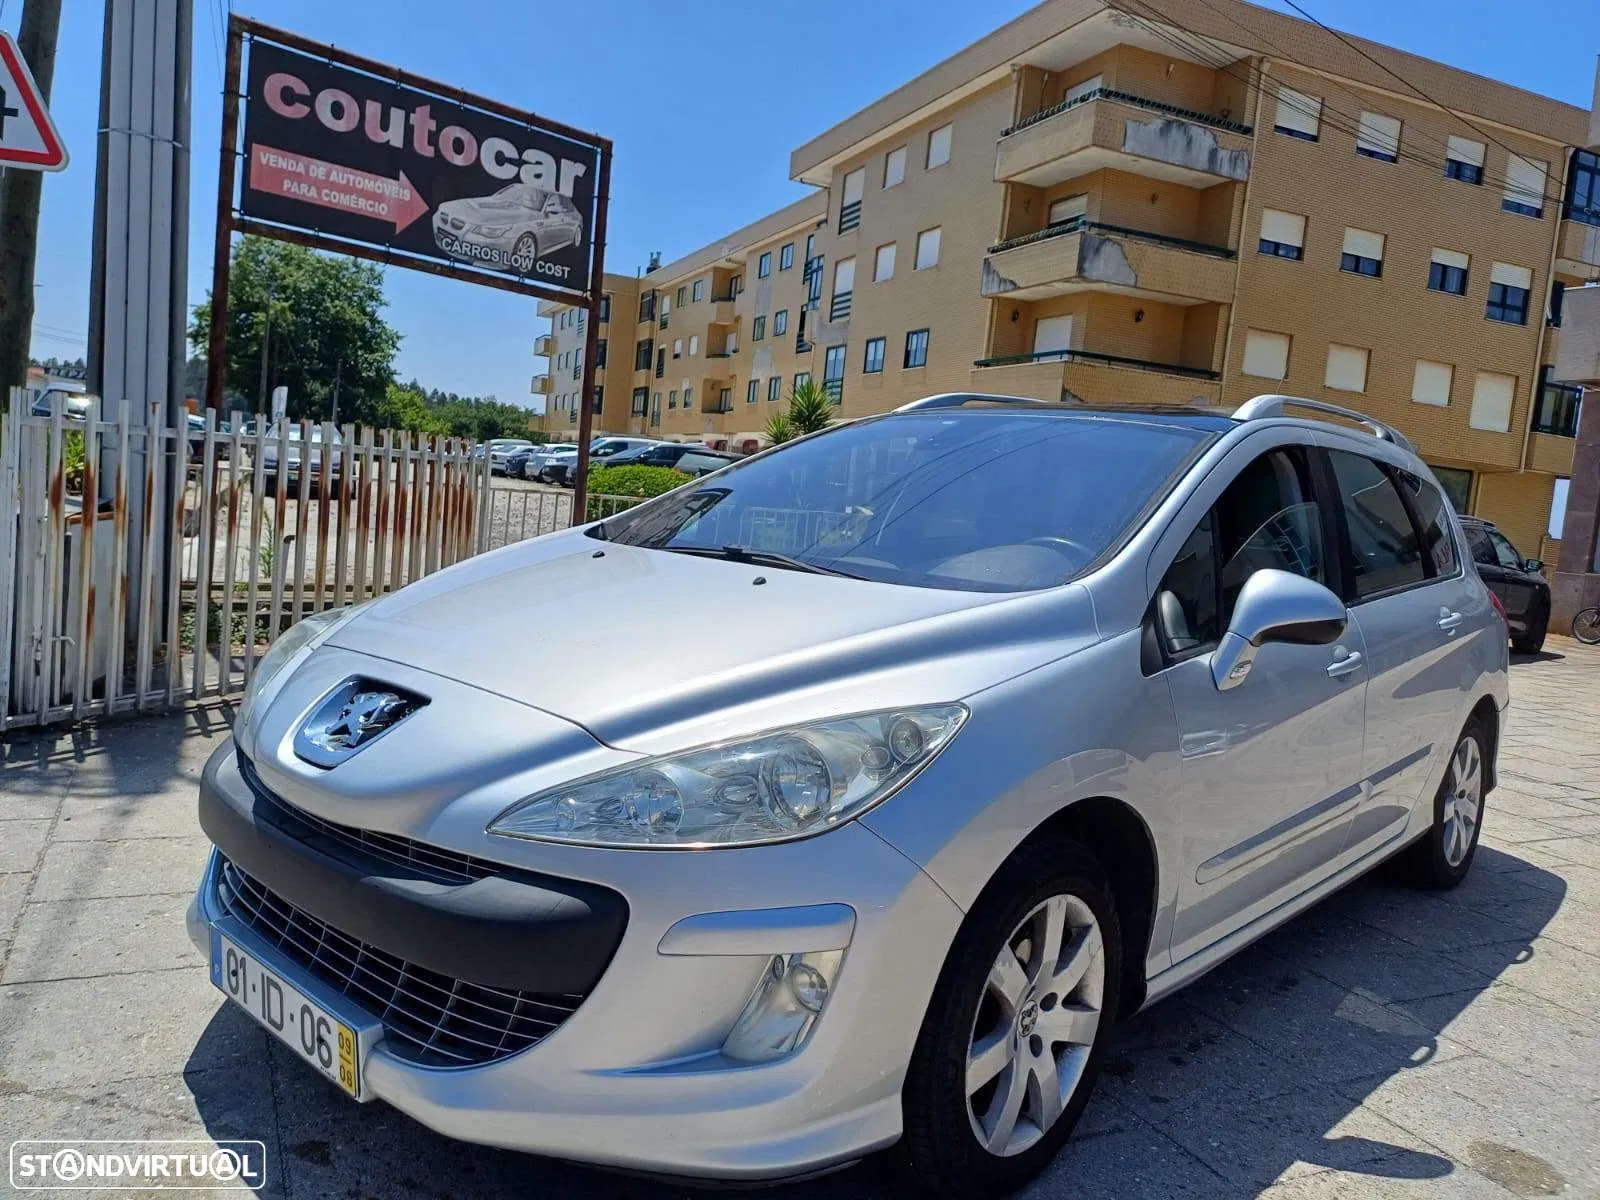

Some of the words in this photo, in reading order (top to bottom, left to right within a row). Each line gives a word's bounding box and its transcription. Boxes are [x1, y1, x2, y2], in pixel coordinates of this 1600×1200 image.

[263, 72, 587, 197] coutocar
[260, 152, 305, 174] VENDA
[309, 165, 326, 180] DE
[329, 170, 411, 202] AUTOMÓVEIS
[283, 179, 318, 199] PARA
[322, 187, 389, 215] COMÉRCIO
[442, 237, 500, 262] CARROS
[503, 251, 533, 271] LOW
[536, 260, 571, 279] COST
[339, 1064, 353, 1088] 08
